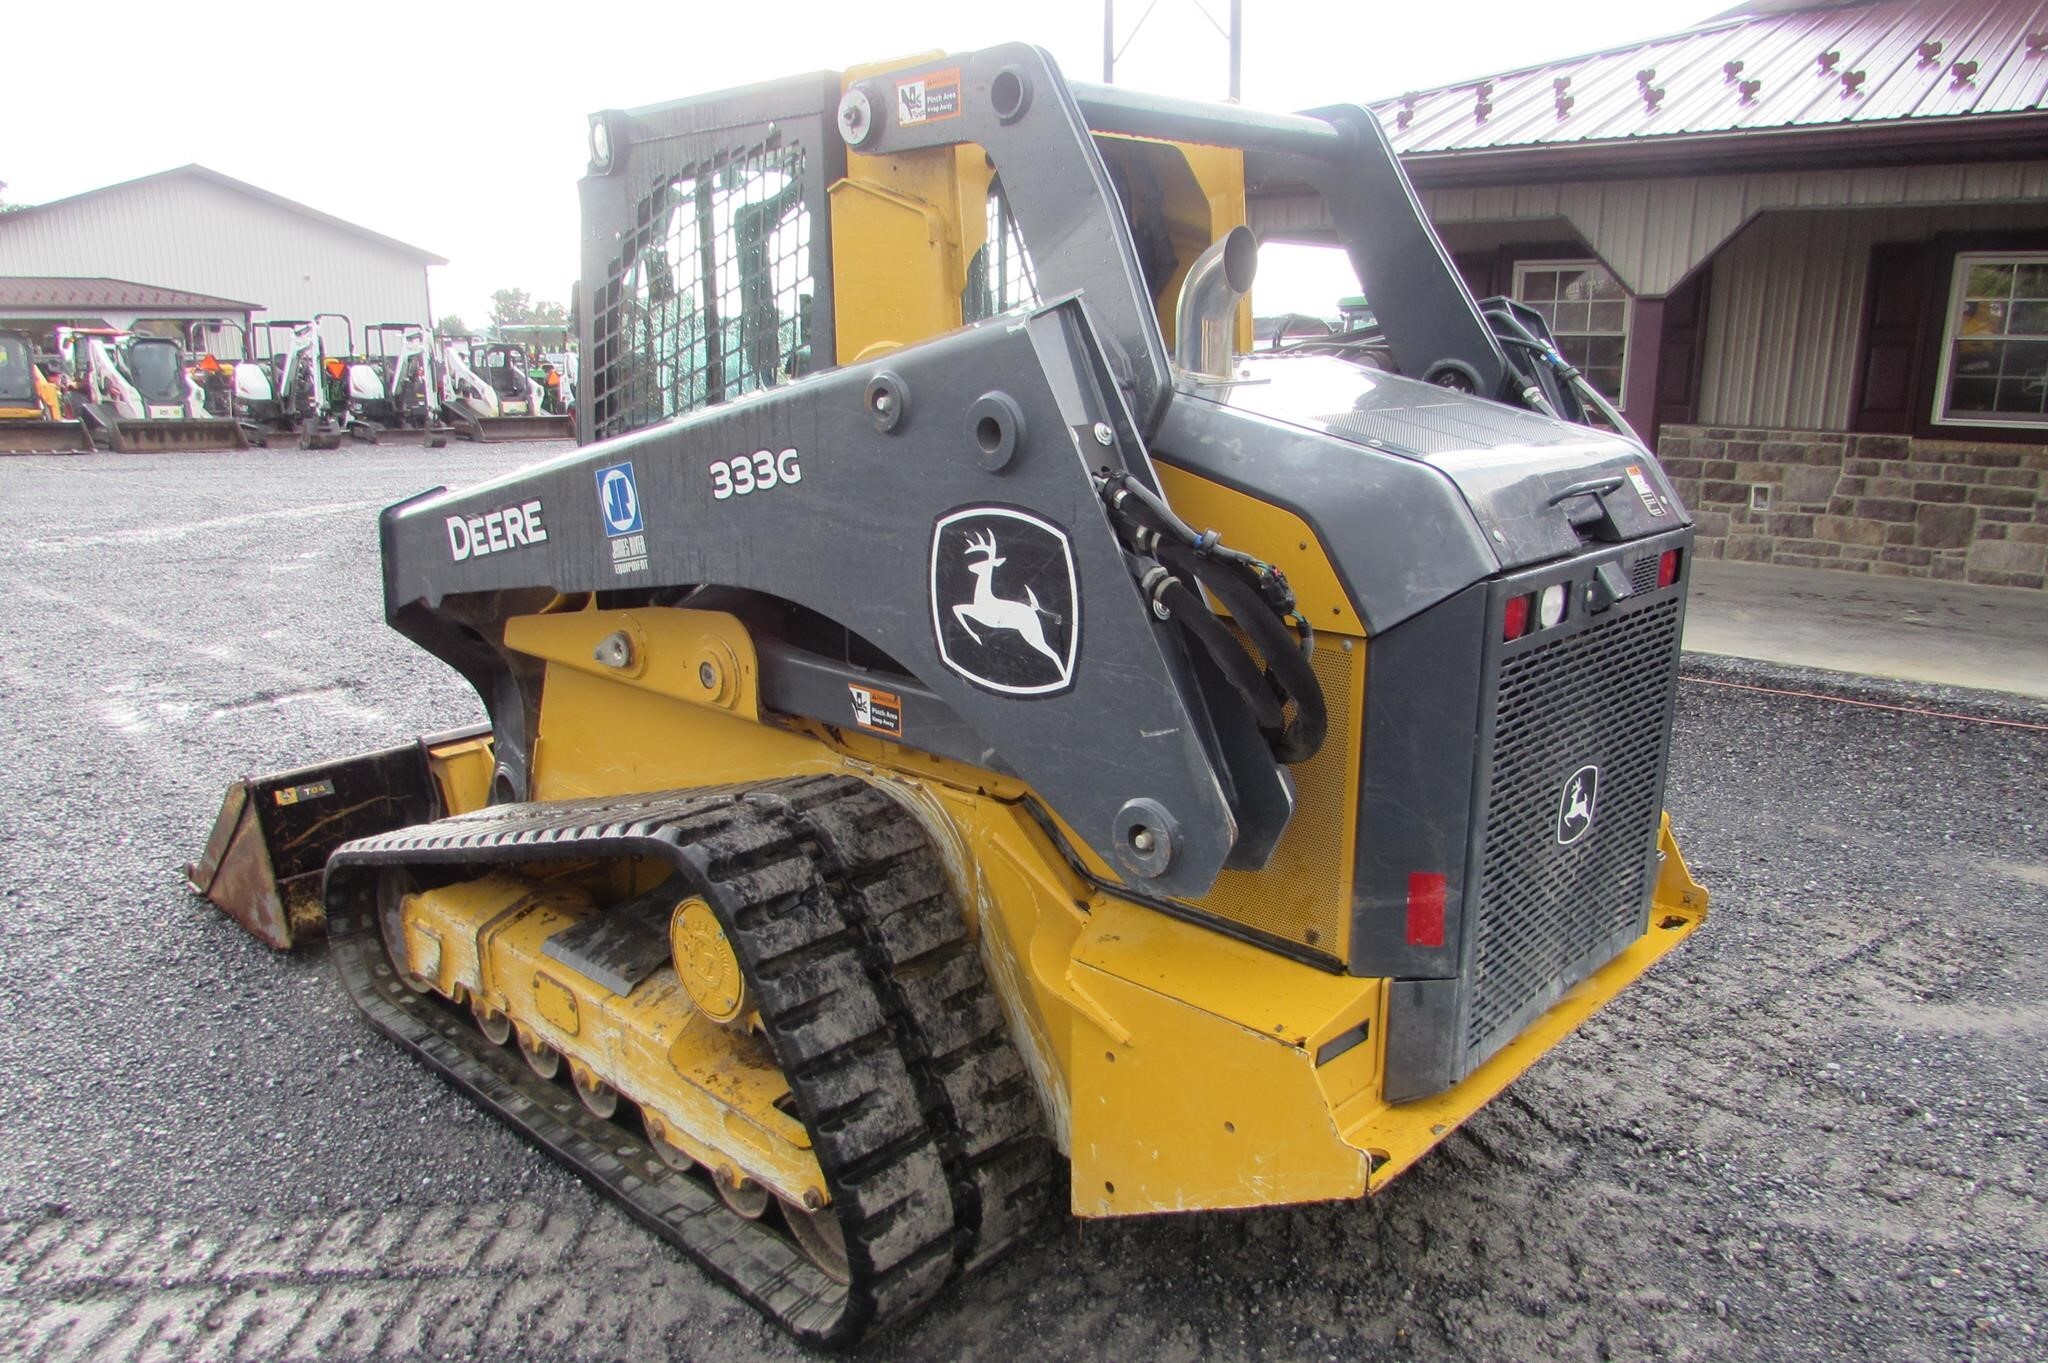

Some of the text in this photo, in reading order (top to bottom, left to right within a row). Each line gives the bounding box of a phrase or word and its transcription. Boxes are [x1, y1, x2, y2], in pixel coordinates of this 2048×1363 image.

[709, 449, 802, 500] 333G
[445, 500, 548, 562] DEERE
[886, 711, 898, 721] Area
